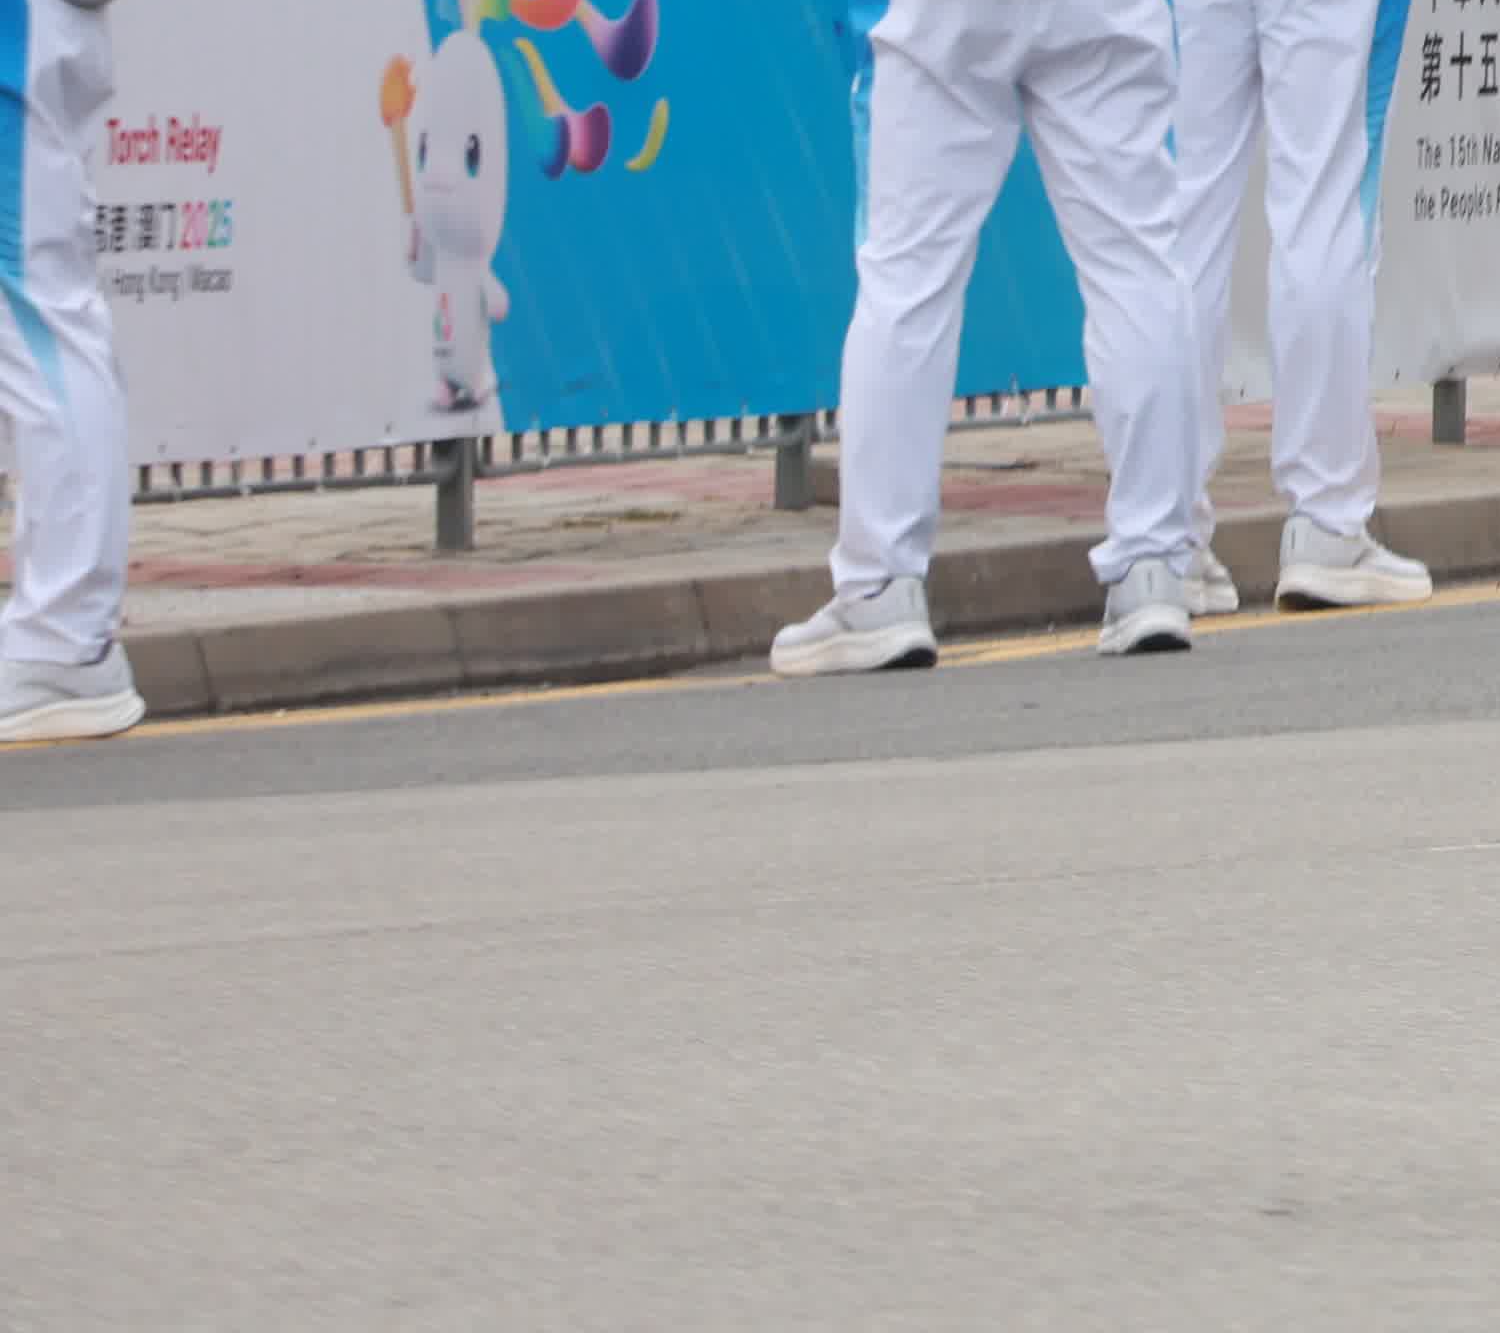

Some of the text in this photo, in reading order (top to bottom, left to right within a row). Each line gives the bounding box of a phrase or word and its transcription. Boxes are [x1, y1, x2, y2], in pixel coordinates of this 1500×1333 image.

[106, 113, 224, 175] Torch Relay
[1416, 136, 1442, 169] The
[1449, 132, 1479, 166] 15th
[1414, 186, 1436, 221] the
